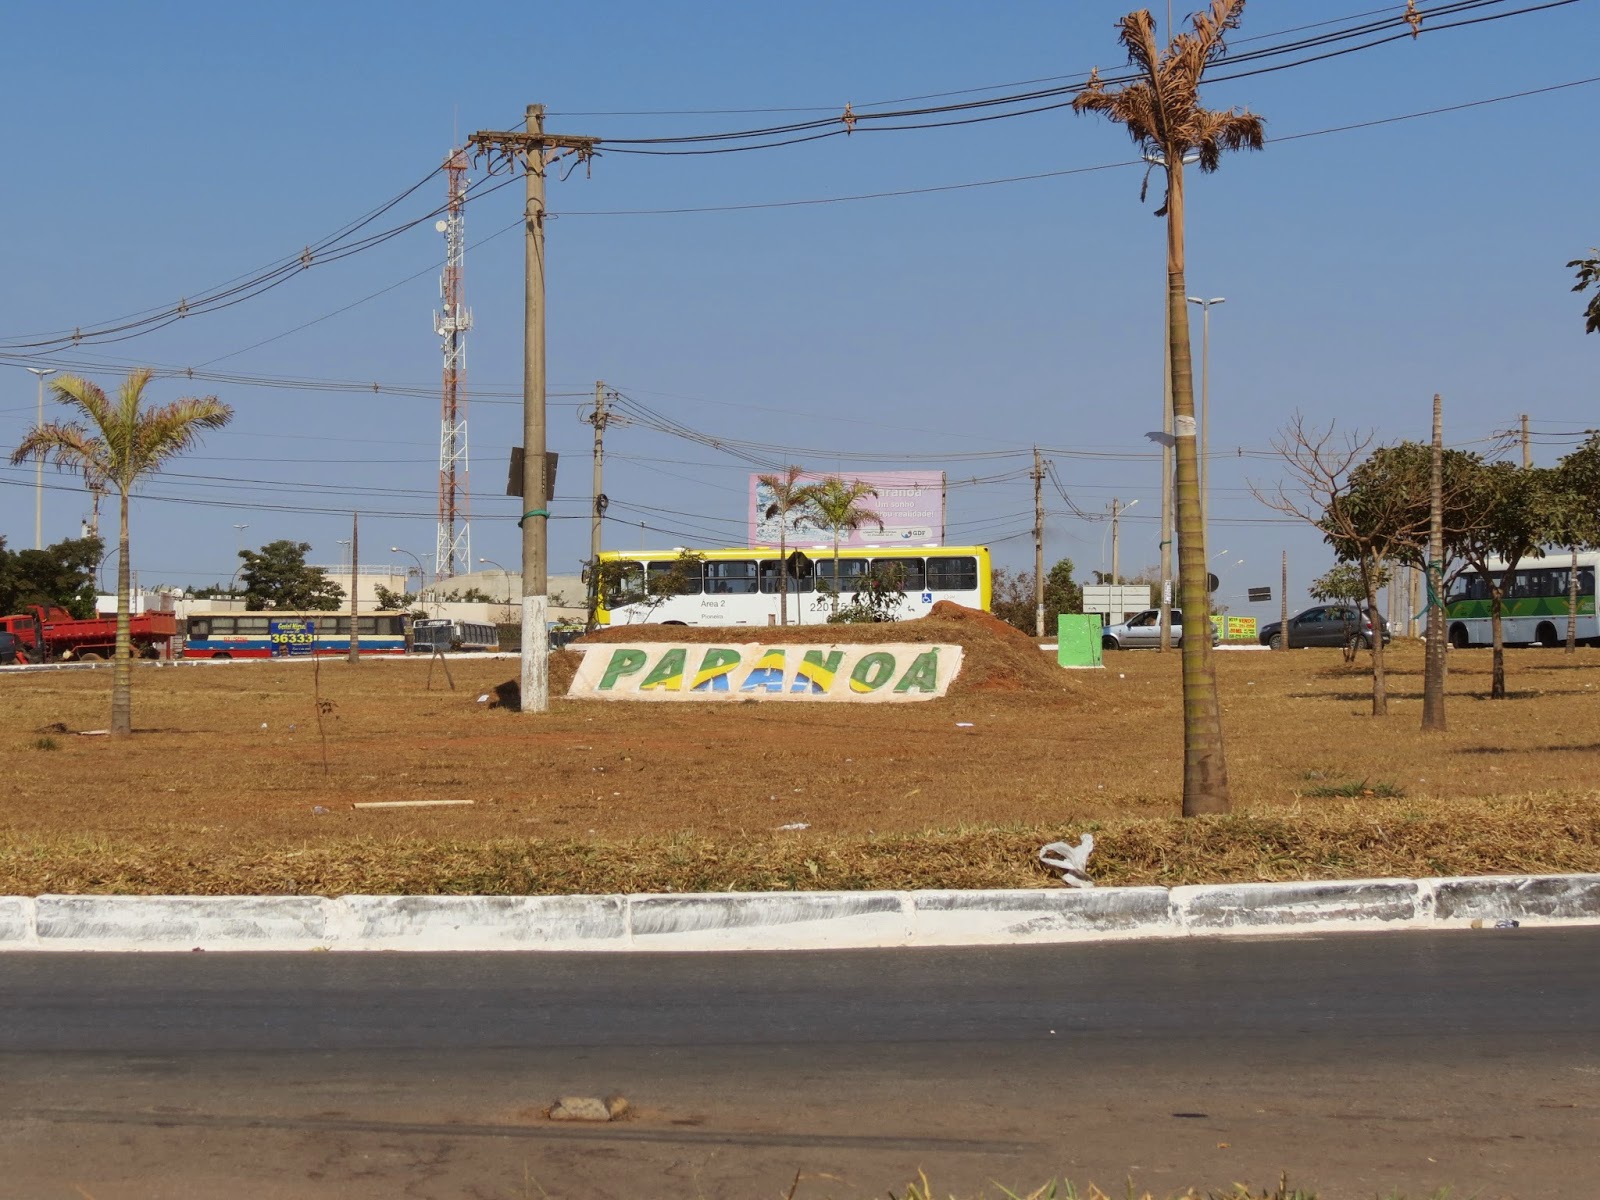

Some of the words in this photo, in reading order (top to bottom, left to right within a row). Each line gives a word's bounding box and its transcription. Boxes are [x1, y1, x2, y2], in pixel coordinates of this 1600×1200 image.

[891, 500, 915, 508] sonho
[895, 510, 934, 518] realidade!
[700, 599, 719, 608] Área
[272, 634, 313, 643] 36333
[597, 647, 942, 695] PARANOÁ
